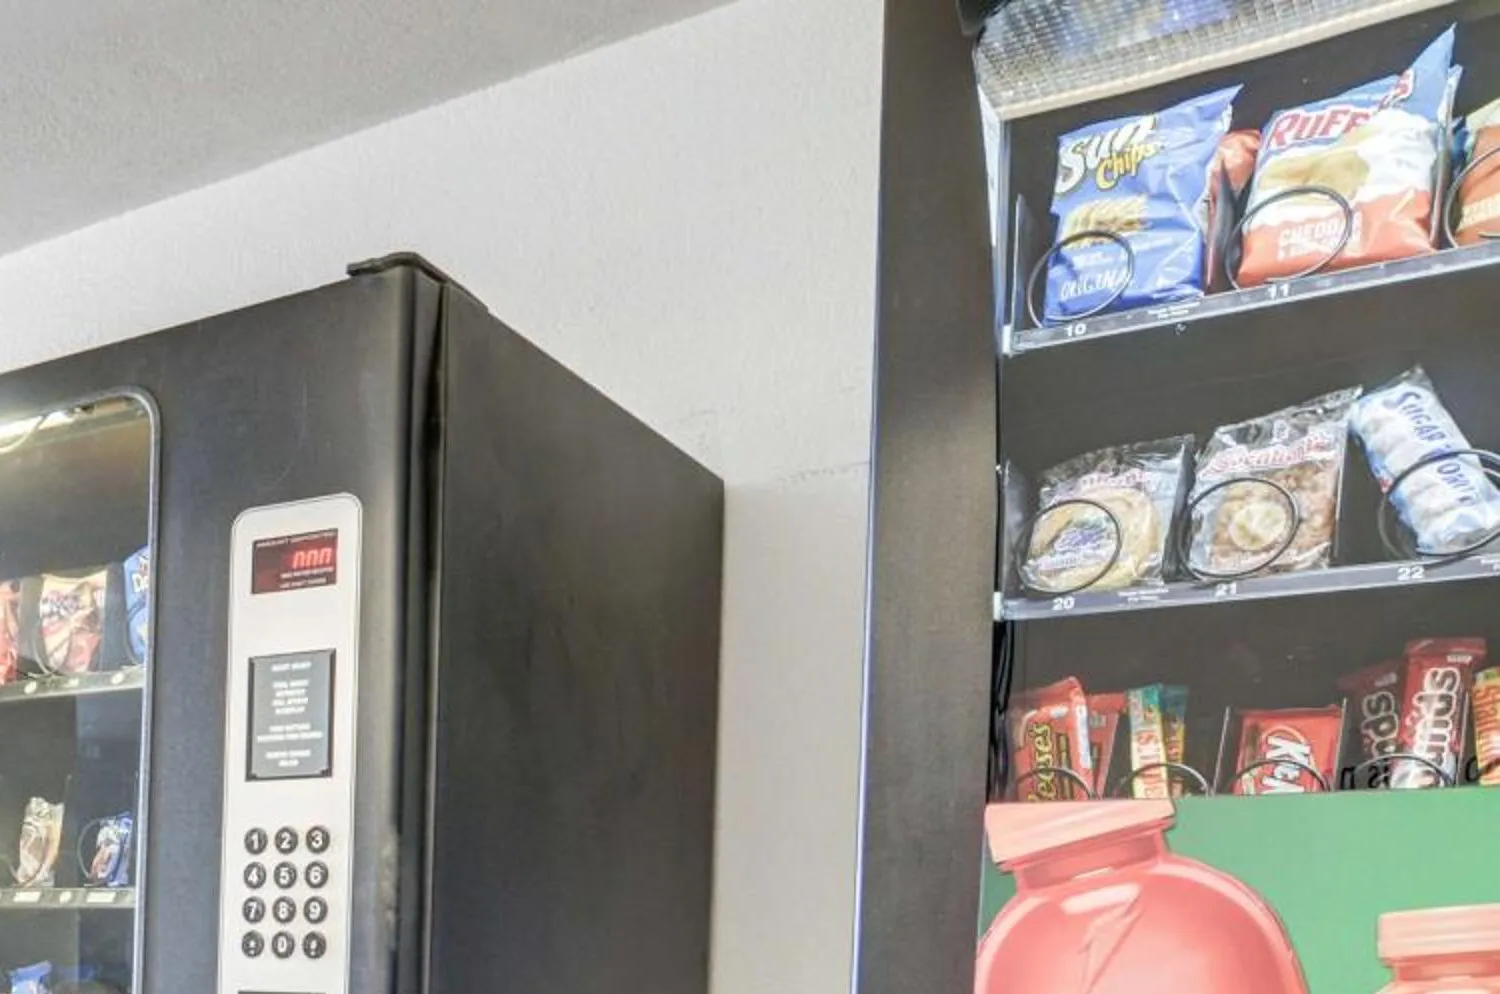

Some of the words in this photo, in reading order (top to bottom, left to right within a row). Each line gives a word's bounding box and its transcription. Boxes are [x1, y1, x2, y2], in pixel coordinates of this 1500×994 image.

[1269, 67, 1416, 148] RUFFS
[1054, 114, 1159, 194] Sun
[1095, 142, 1163, 190] Chips
[1061, 267, 1133, 301] ORIGINA
[1268, 283, 1291, 299] 11
[1066, 323, 1087, 337] 10
[1399, 566, 1425, 581] 22
[1215, 582, 1238, 597] 21
[1053, 597, 1076, 610] 20
[251, 831, 260, 850] 1
[280, 831, 292, 849] 2
[311, 830, 323, 849] 3
[247, 867, 259, 885] 4
[279, 867, 290, 885] 5
[309, 865, 322, 885] 6
[248, 901, 258, 919] 7
[309, 901, 321, 919] 9
[277, 935, 288, 953] 0
